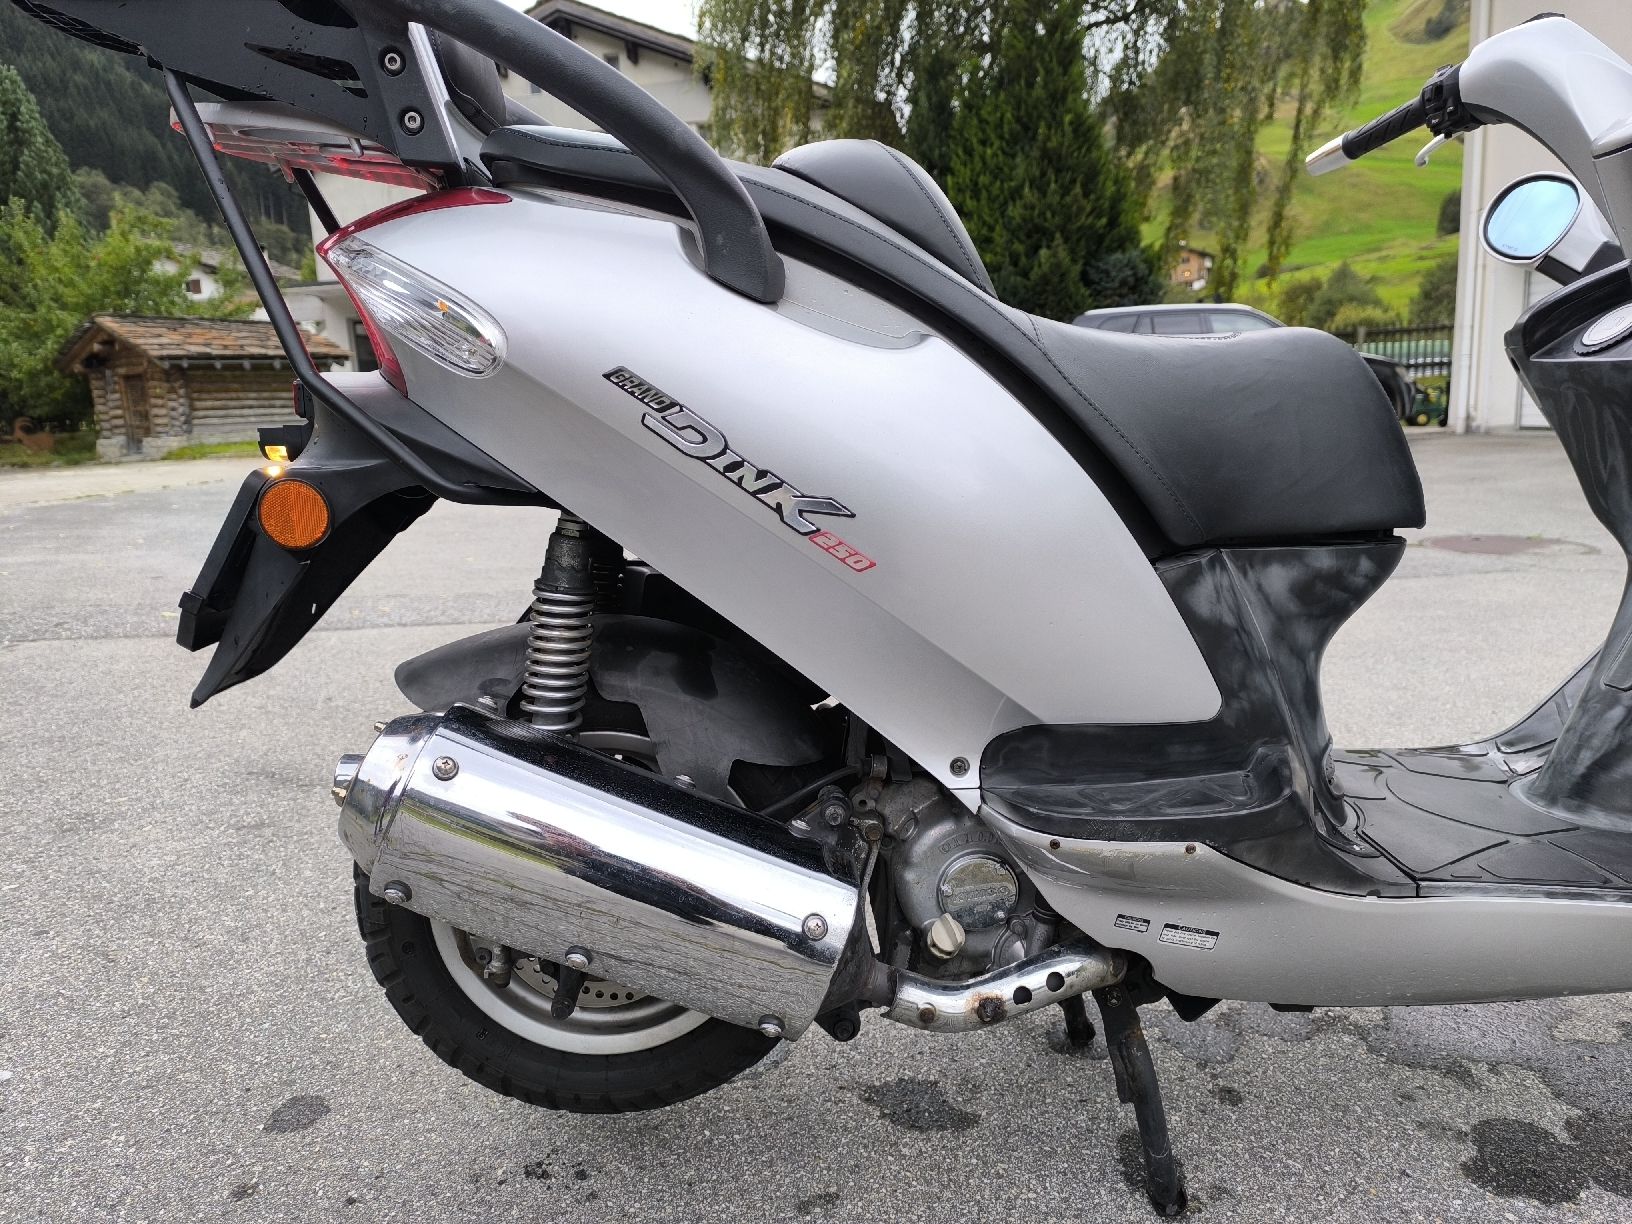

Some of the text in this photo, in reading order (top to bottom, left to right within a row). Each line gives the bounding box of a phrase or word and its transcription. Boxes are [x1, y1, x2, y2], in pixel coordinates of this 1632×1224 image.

[609, 368, 876, 572] GRAND DINK 250
